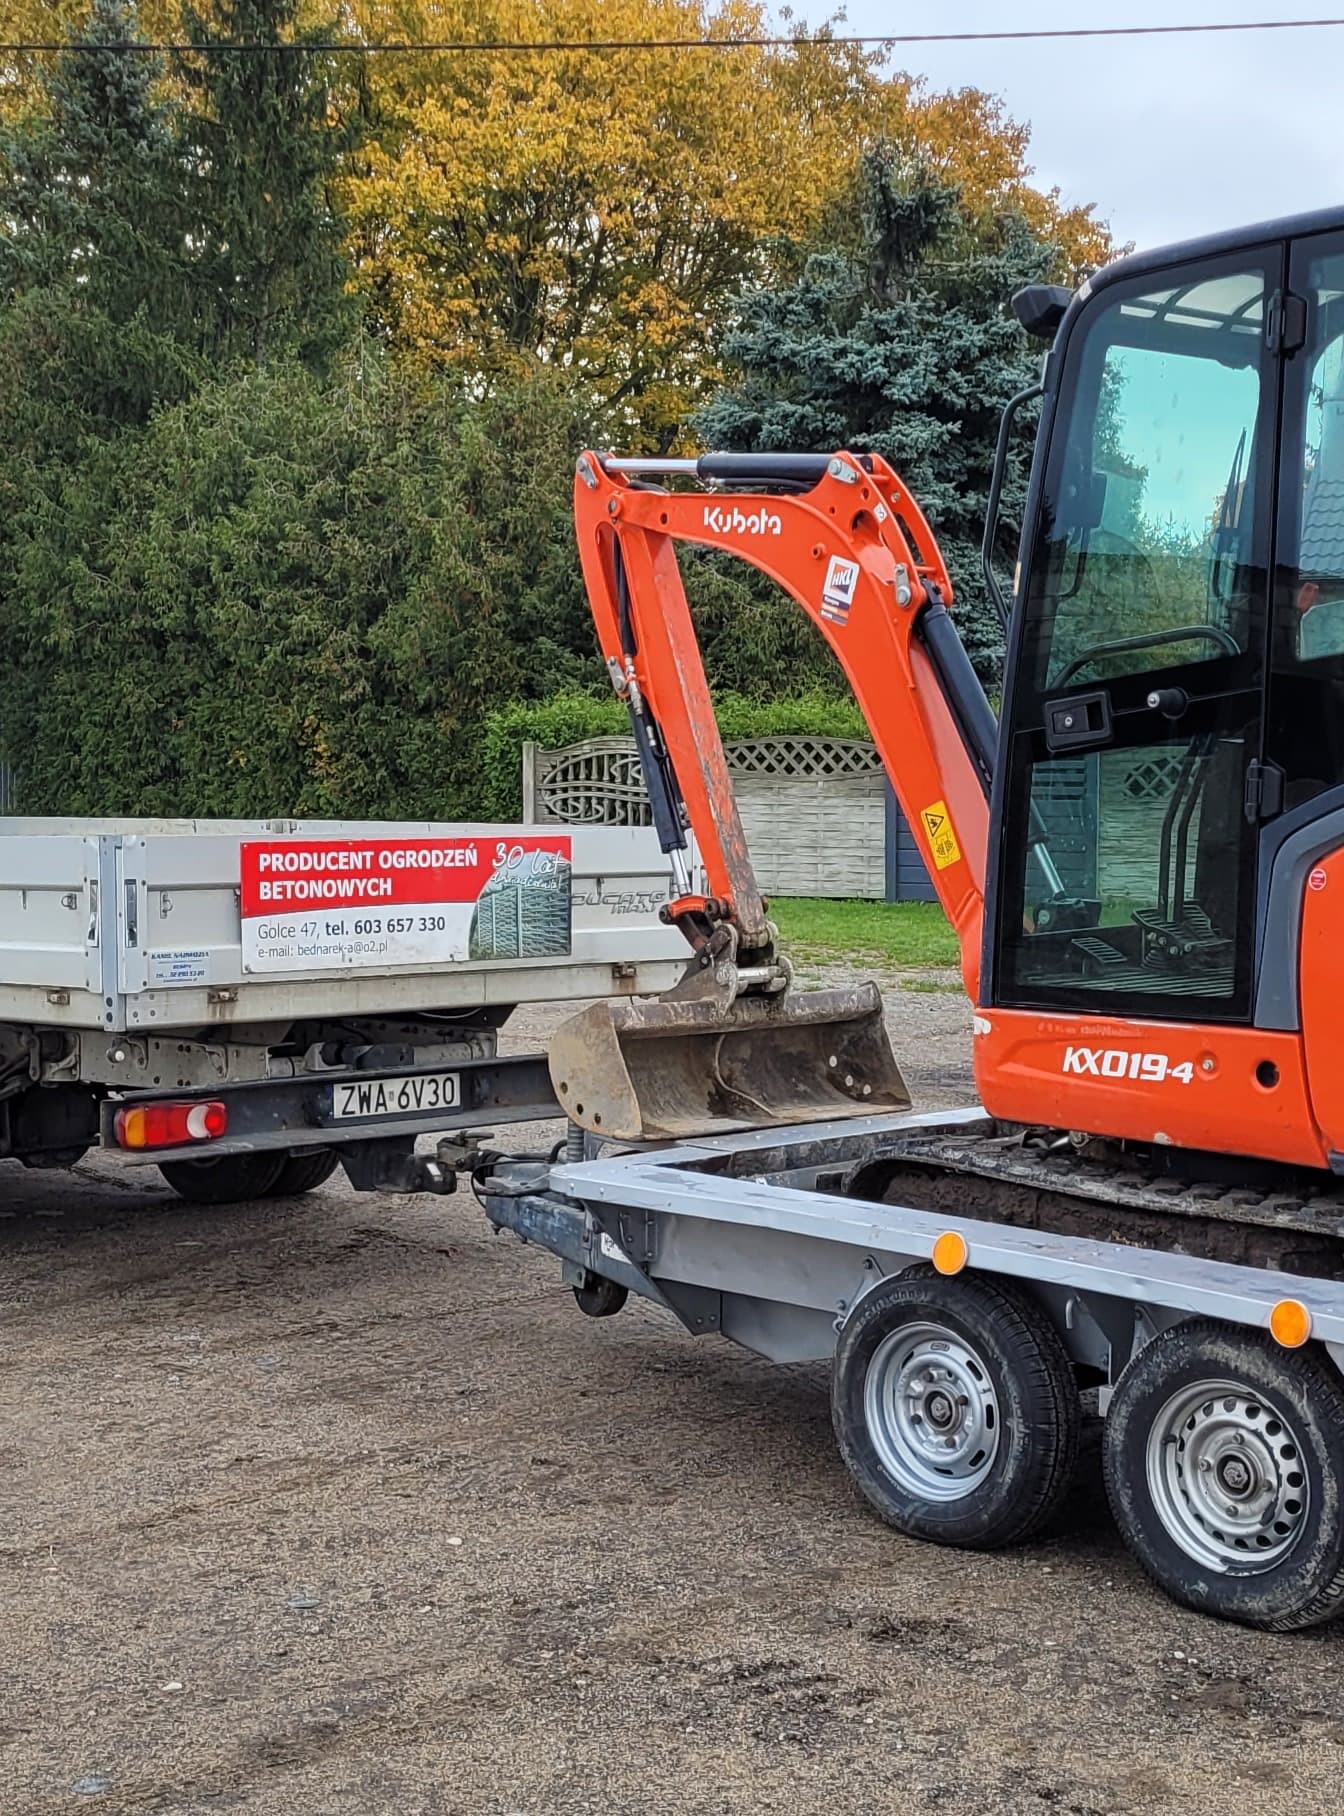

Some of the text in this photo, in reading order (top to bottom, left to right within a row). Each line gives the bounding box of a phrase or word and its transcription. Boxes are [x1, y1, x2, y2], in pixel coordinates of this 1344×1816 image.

[703, 506, 781, 535] Kubota
[258, 843, 478, 872] PRODUCENT OGRODZEŃ
[492, 842, 567, 875] 30 lat
[259, 878, 392, 900] BETONOWYCH
[258, 916, 446, 940] Golce 47, tel. 603 657 330
[257, 940, 388, 959] e-mail: bednarek-a@o2.pl
[1062, 1046, 1194, 1084] KX019-4
[341, 1077, 455, 1115] ZWA 6V30
